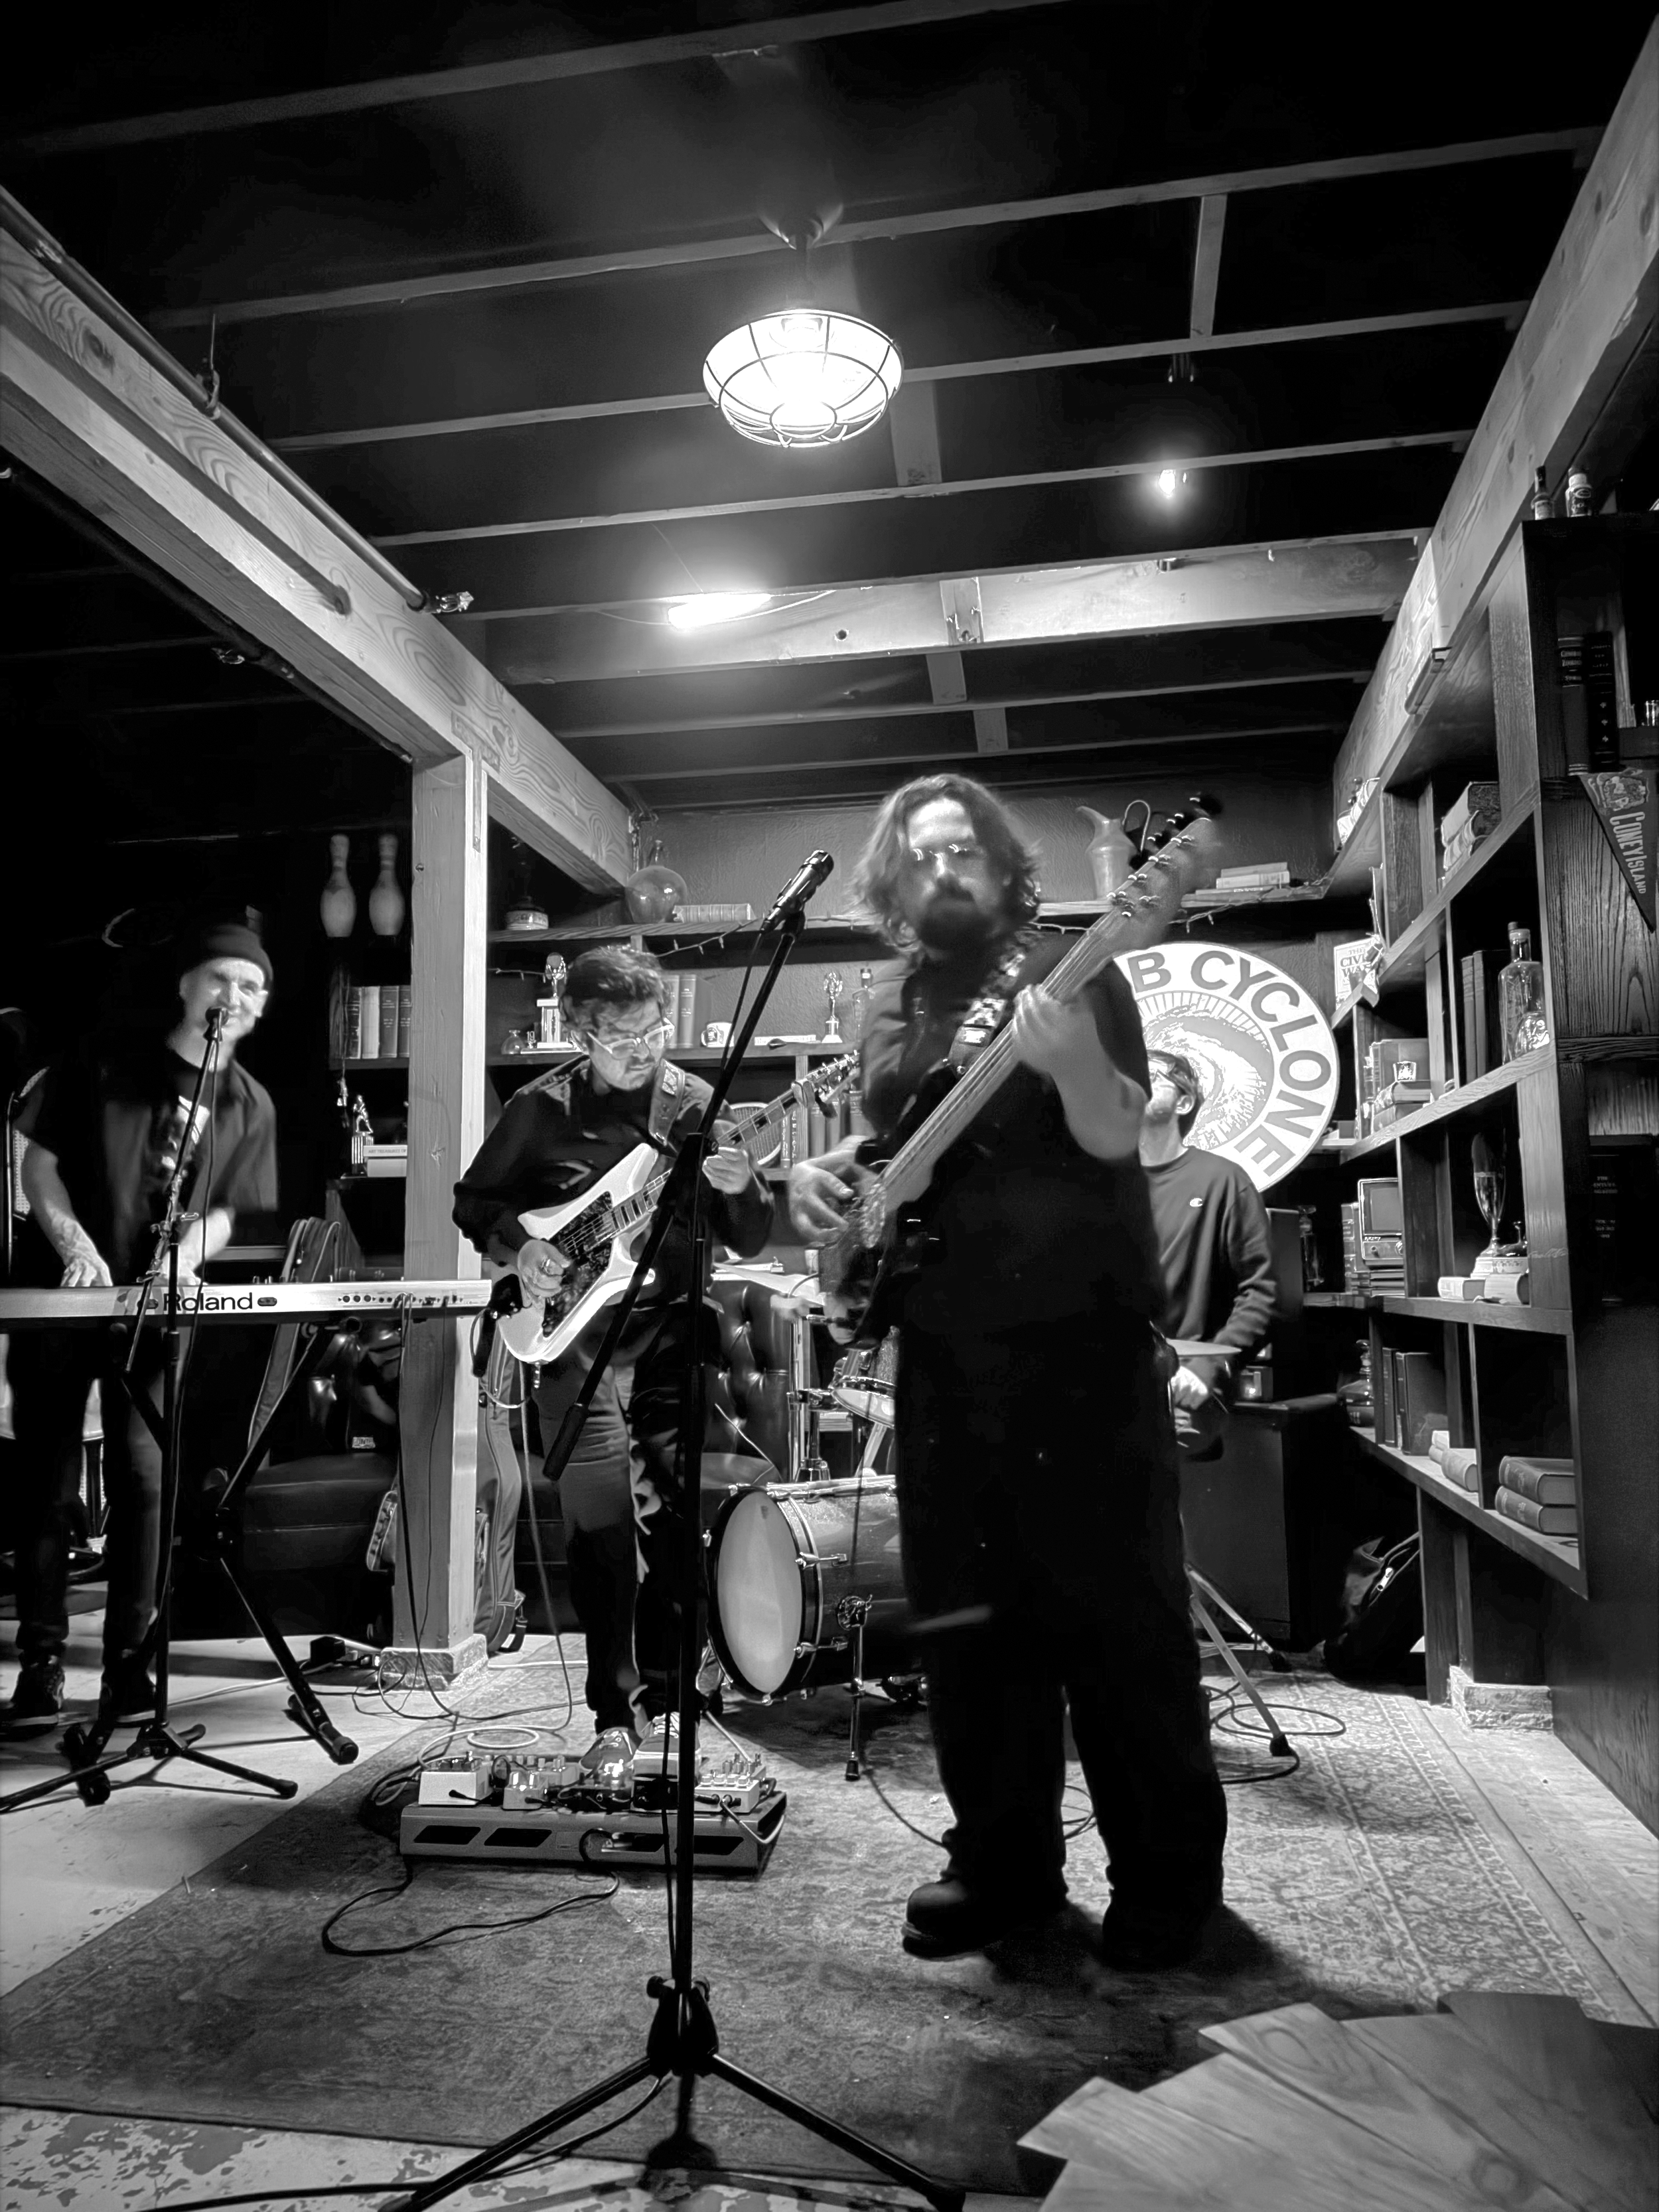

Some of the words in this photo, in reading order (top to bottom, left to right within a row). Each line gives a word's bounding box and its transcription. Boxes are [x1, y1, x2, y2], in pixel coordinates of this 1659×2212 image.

[1609, 811, 1646, 856] CONEY
[1624, 855, 1648, 894] ISLAND
[526, 1031, 535, 1041] 19
[1190, 950, 1332, 1177] CYCLONE
